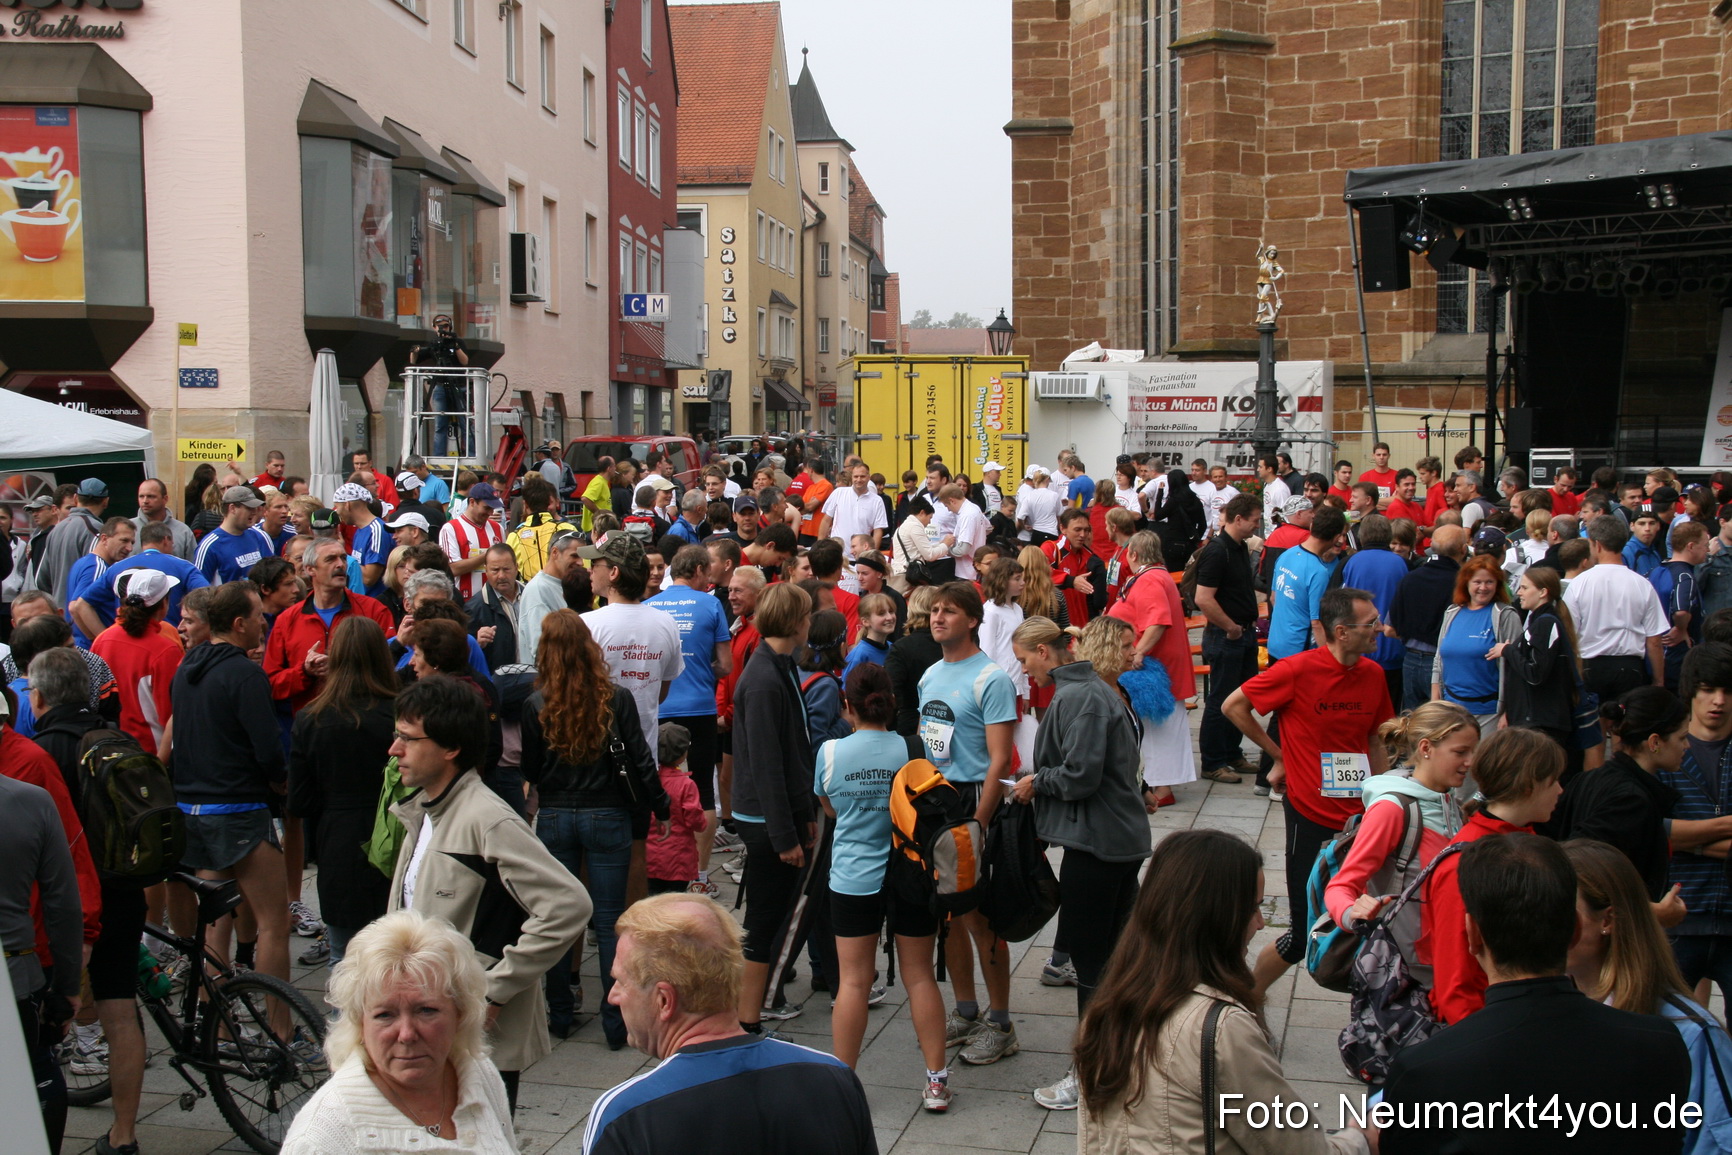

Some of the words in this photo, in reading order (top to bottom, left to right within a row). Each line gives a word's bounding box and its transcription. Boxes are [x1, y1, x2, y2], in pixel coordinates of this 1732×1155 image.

[11, 9, 125, 39] Rathaus
[720, 226, 737, 343] satzke
[1149, 372, 1197, 384] Faszination
[926, 384, 936, 416] 23456
[985, 376, 1004, 431] Müller
[1006, 381, 1014, 431] SPEZIALIST
[1170, 398, 1216, 411] Münch
[1221, 396, 1288, 412] KOK
[189, 441, 226, 450] Kinder-
[182, 451, 233, 461] betreuung
[1006, 443, 1014, 492] GETRÄNKE
[622, 650, 663, 660] Stadtlauf
[1335, 757, 1351, 765] Josef
[1337, 770, 1366, 781] 3632
